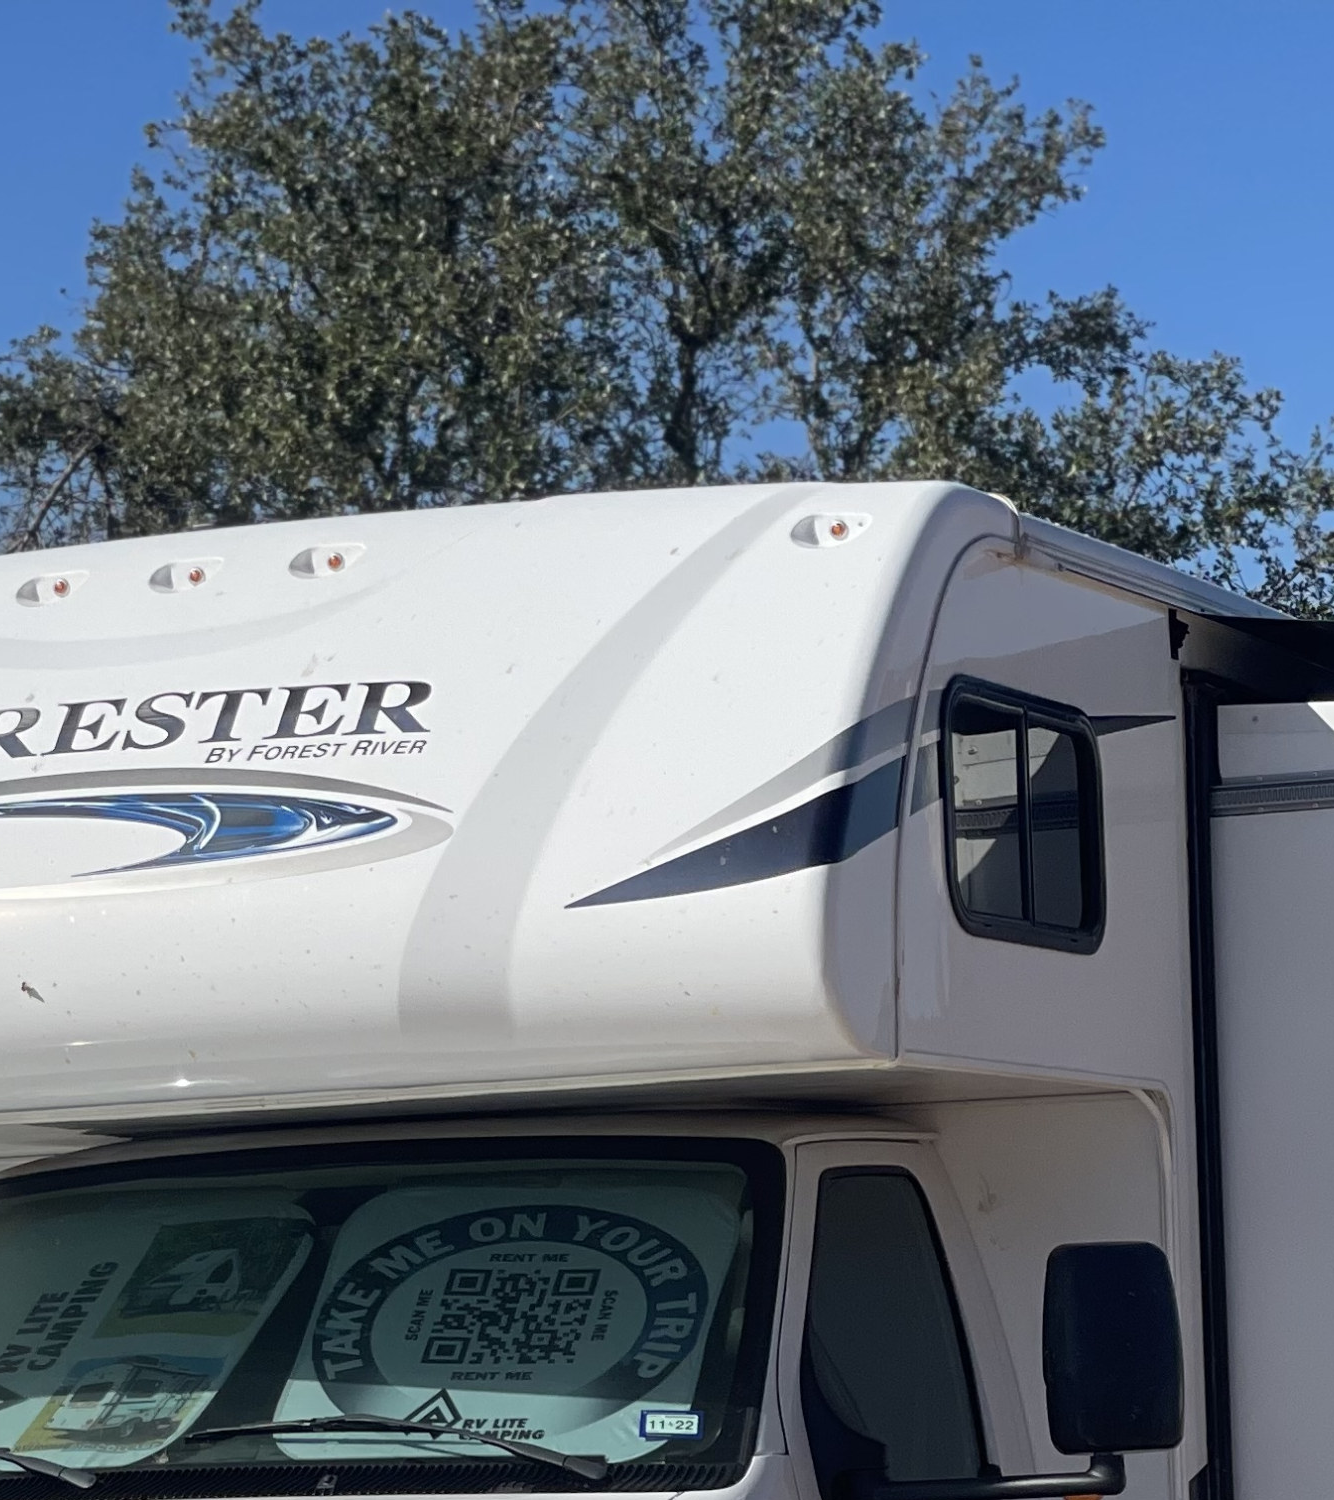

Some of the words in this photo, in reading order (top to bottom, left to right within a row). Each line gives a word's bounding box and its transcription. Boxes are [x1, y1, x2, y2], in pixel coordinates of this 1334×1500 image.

[205, 747, 240, 764] BY
[247, 743, 347, 762] FOREST
[350, 738, 428, 757] RIVER
[489, 1253, 538, 1263] RENT
[541, 1253, 571, 1263] ME
[323, 1282, 385, 1381] TAKE
[369, 1228, 455, 1280] ME
[468, 1213, 546, 1242] ON
[572, 1215, 687, 1286] YOUR
[633, 1291, 698, 1380] TRIP
[599, 1290, 620, 1320] SCAN
[16, 1290, 69, 1335] LITE
[27, 1261, 120, 1371] CAMPING
[405, 1307, 427, 1341] SCAN
[418, 1289, 435, 1306] ME
[592, 1321, 612, 1341] ME
[449, 1371, 501, 1381] RENT
[504, 1371, 533, 1381] ME
[459, 1429, 546, 1440] CMPING
[462, 1418, 488, 1429] RV
[492, 1417, 529, 1429] LITE
